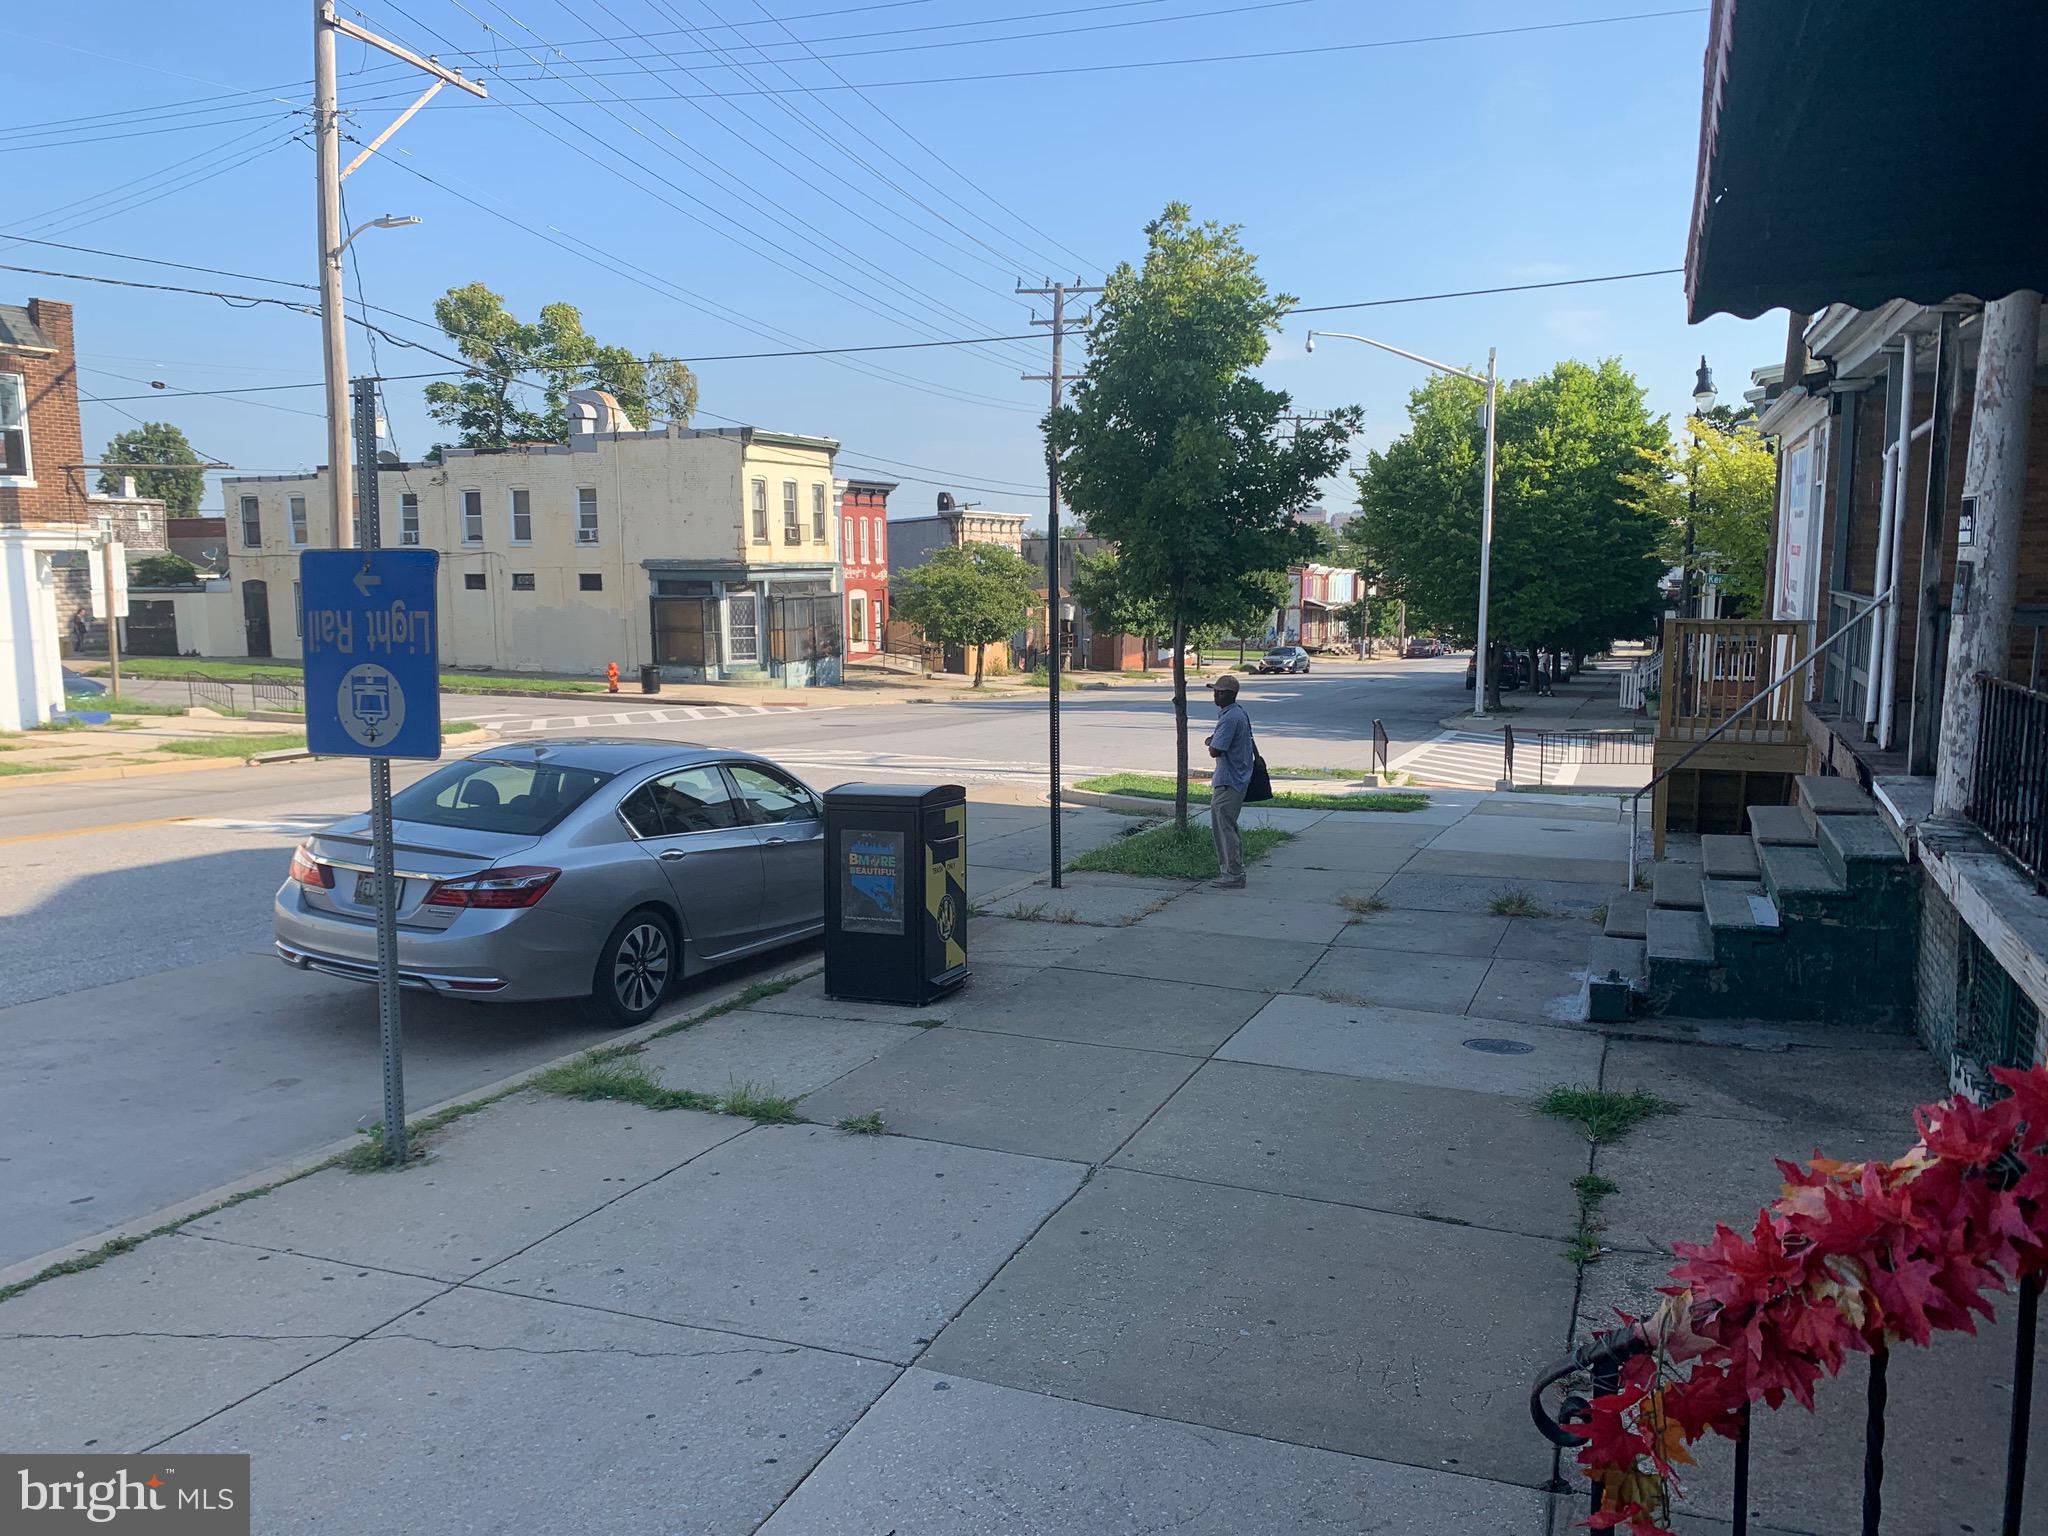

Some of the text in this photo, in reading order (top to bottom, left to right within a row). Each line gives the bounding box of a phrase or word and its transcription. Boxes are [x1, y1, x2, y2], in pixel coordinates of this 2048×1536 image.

[308, 600, 430, 655] Light Rail
[850, 866, 897, 877] BEAUTIFUL
